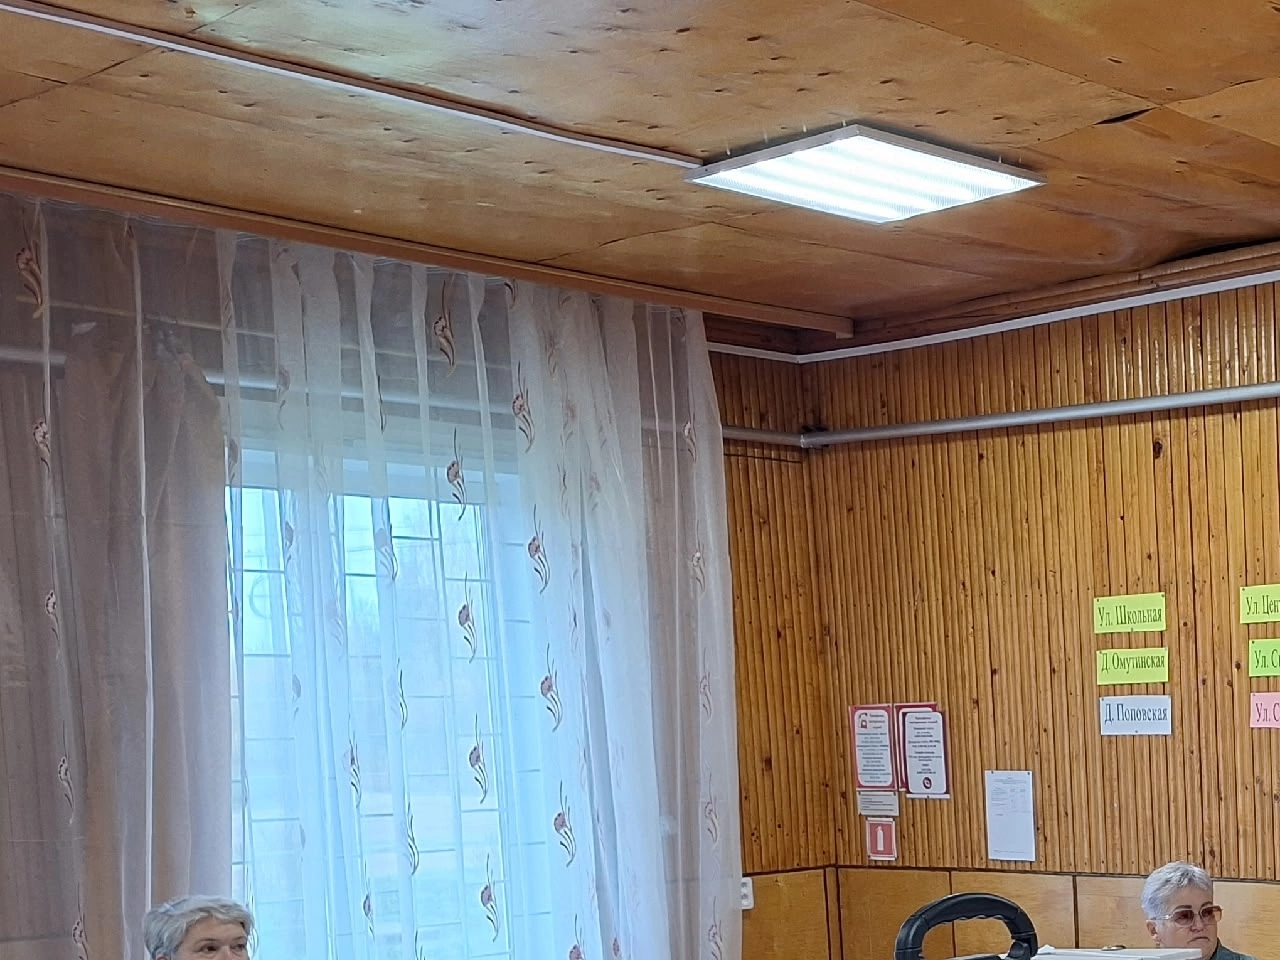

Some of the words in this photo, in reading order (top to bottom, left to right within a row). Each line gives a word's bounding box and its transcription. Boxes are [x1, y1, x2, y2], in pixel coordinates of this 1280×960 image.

[1098, 606, 1113, 627] Ул.
[1115, 604, 1162, 625] Школьная
[1245, 596, 1260, 615] Ул.
[1112, 652, 1165, 674] Омутинская
[1254, 649, 1269, 669] Ул.
[1104, 703, 1115, 725] Д.
[1116, 702, 1168, 721] Поповская
[1255, 702, 1271, 722] Ул.
